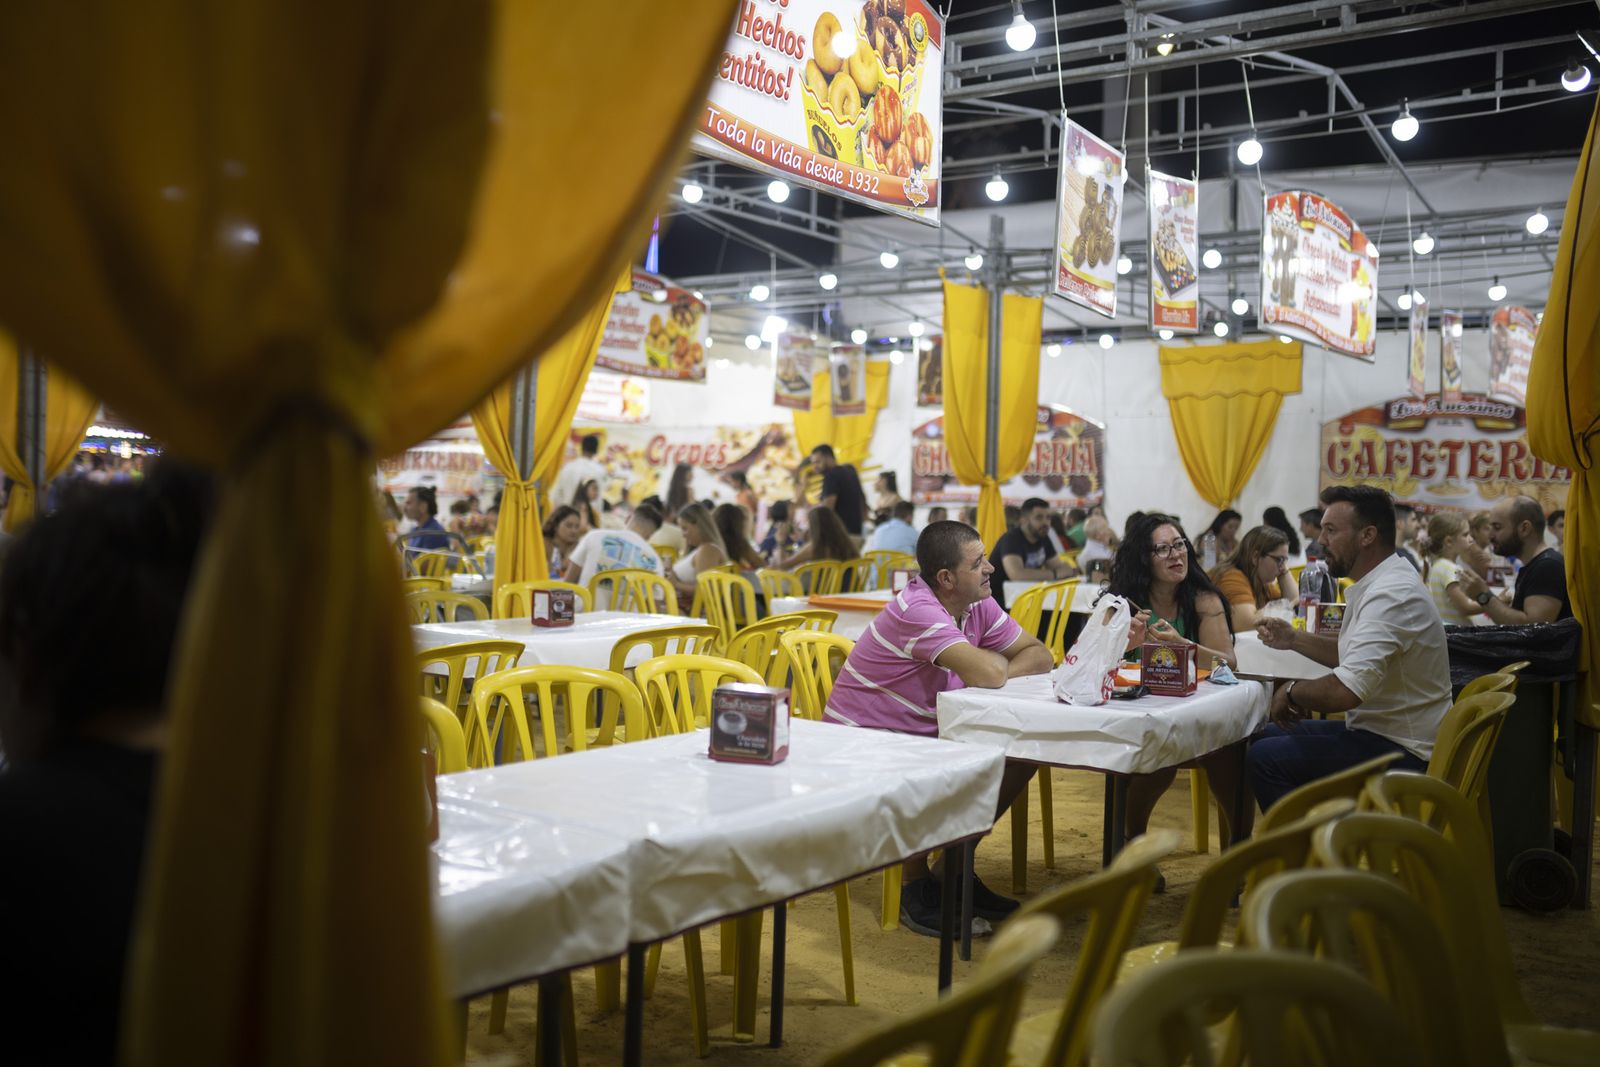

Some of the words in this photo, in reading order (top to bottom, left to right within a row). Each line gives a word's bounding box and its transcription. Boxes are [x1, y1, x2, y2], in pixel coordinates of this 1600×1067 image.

[737, 0, 806, 60] Hechos
[719, 50, 794, 101] entitos!
[707, 107, 747, 146] Toda
[751, 129, 765, 155] la
[771, 139, 801, 170] Vida
[805, 155, 844, 184] desde
[847, 169, 880, 195] 1932
[646, 434, 728, 466] Crepes
